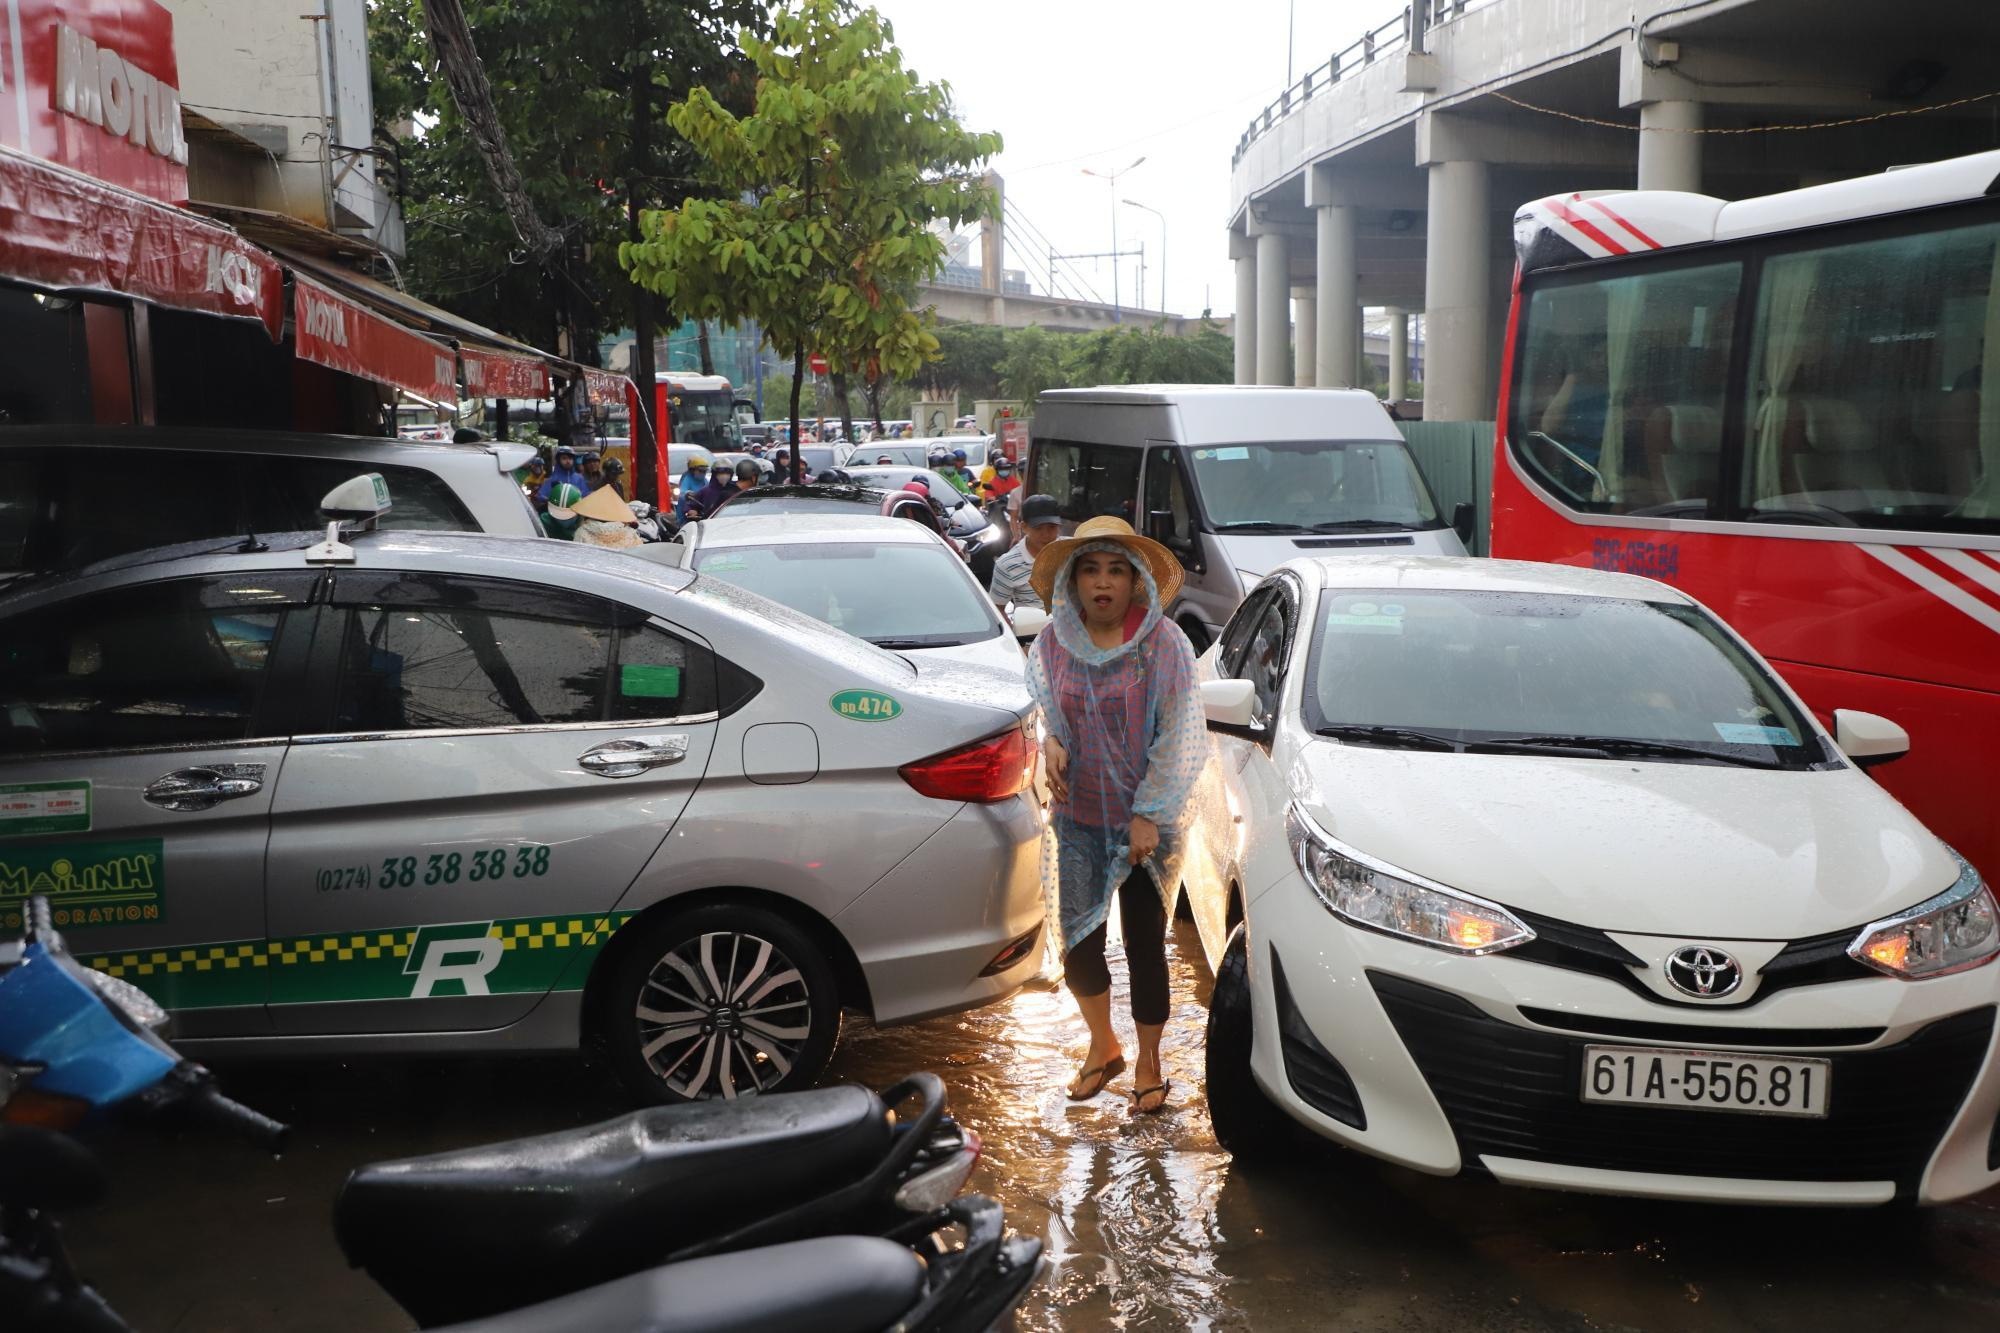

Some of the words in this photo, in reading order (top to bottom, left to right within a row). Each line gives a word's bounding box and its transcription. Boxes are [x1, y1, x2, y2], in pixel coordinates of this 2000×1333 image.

[56, 21, 189, 167] MOTUL
[315, 863, 372, 892] (0274)
[378, 856, 418, 889] 38
[423, 852, 463, 885] 38
[468, 848, 507, 882] 38
[512, 845, 551, 878] 38
[0, 904, 158, 928] OORATION
[1592, 1054, 1812, 1110] 61A-556.81
